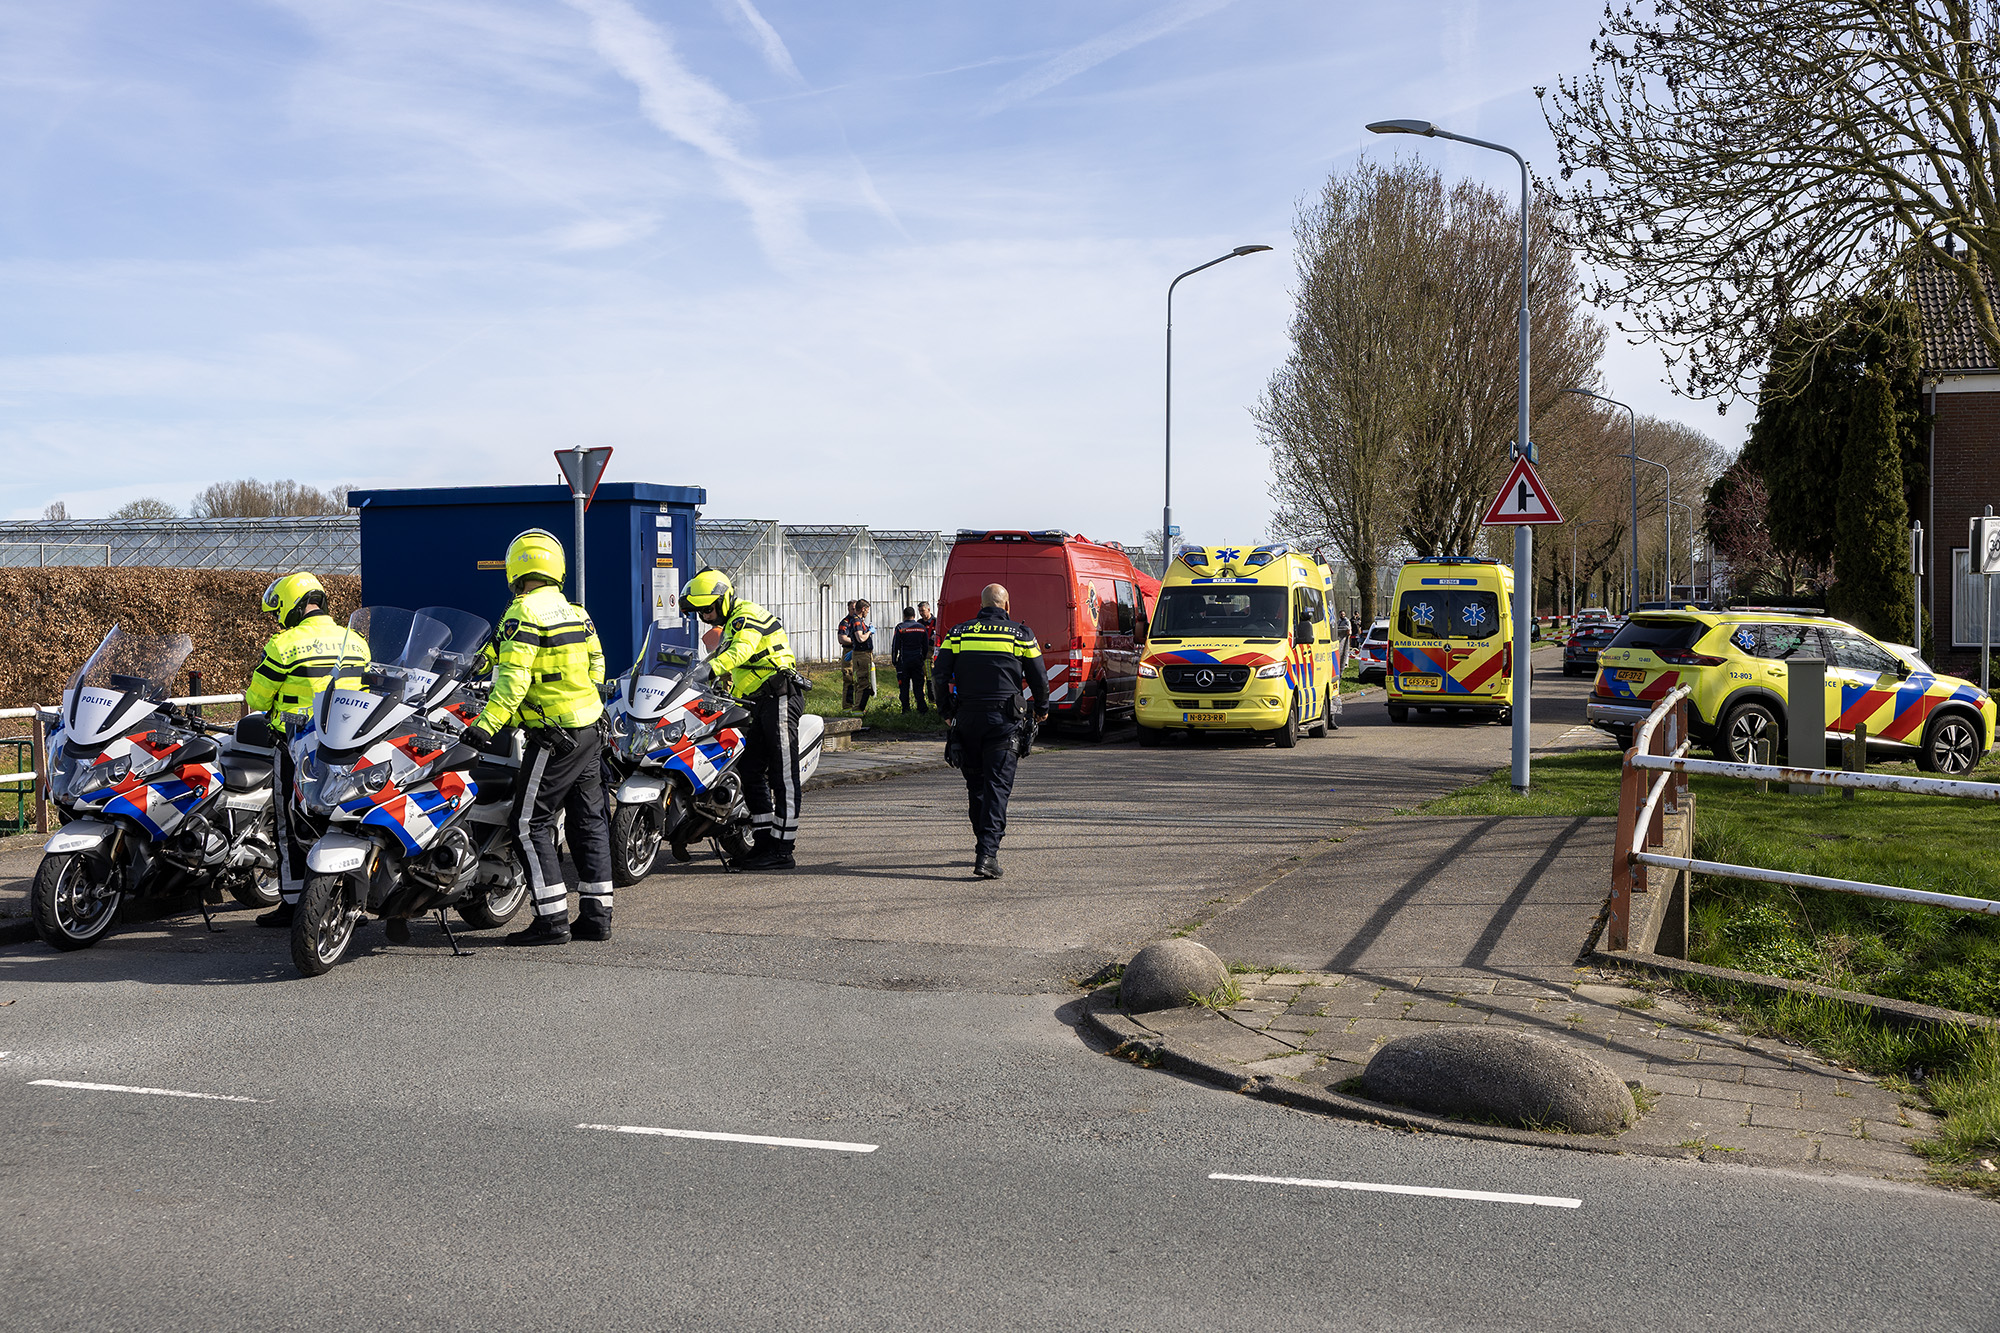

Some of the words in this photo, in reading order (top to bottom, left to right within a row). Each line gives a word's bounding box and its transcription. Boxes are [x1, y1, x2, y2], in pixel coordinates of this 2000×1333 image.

[518, 551, 551, 563] POLITI
[968, 621, 1010, 633] POLITIE
[408, 673, 433, 685] OLITIE
[1729, 671, 1753, 680] 12-803
[637, 687, 665, 697] POLITIE
[81, 695, 113, 707] POLITIE
[334, 697, 370, 710] POLITIE
